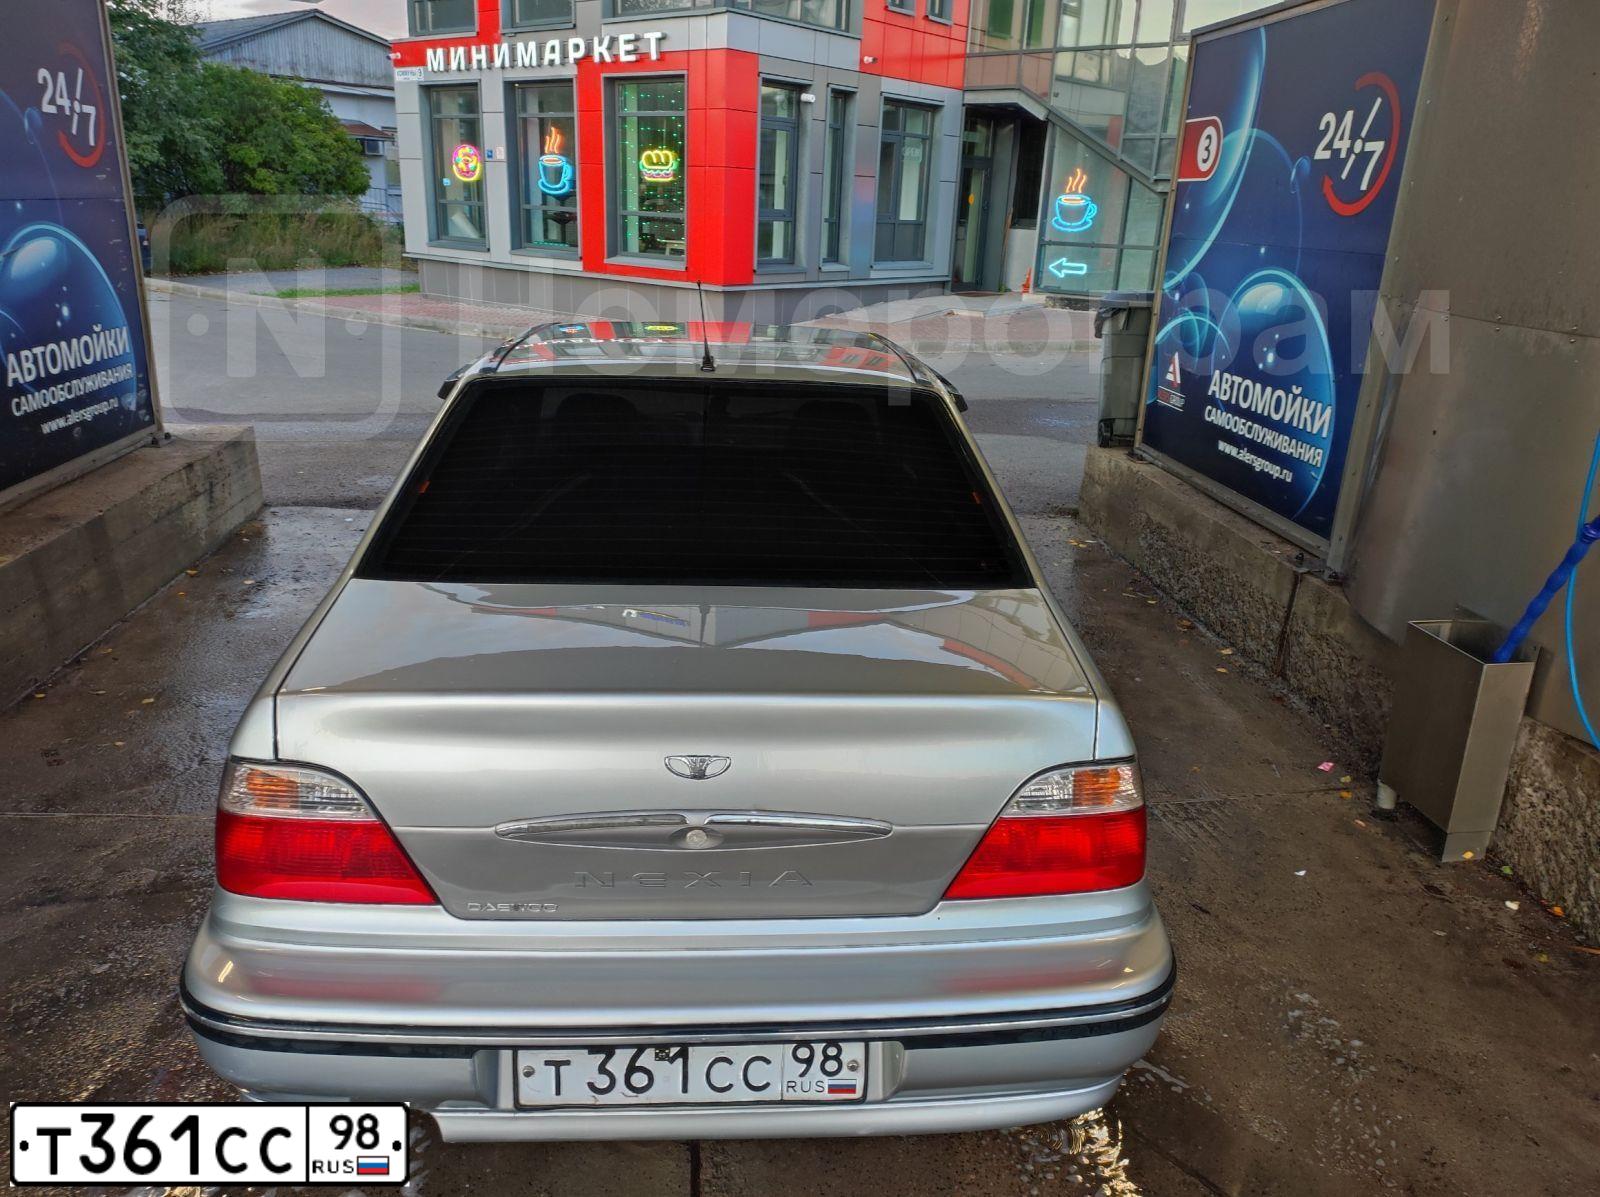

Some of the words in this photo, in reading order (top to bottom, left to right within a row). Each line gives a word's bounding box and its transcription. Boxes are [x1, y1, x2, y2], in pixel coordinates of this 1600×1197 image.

[426, 31, 665, 72] МИНИМАРКЕТ
[37, 67, 97, 146] 24/7
[1202, 134, 1212, 164] 3
[1313, 97, 1385, 190] 24/7
[6, 323, 130, 387] АВТОМОЙКИ
[11, 363, 133, 417] САМООБСЛУЖИВАНИЯ
[1207, 369, 1332, 438] АВТОМОЙКИ
[40, 396, 119, 434] www.alersgroup.ru
[1204, 405, 1323, 468] САМООБСЛУЖИВАНИЯ
[1217, 439, 1293, 482] www.alersgroup.ru
[574, 870, 814, 888] NEXIA
[791, 1042, 843, 1078] 98
[785, 1080, 825, 1094] RUS
